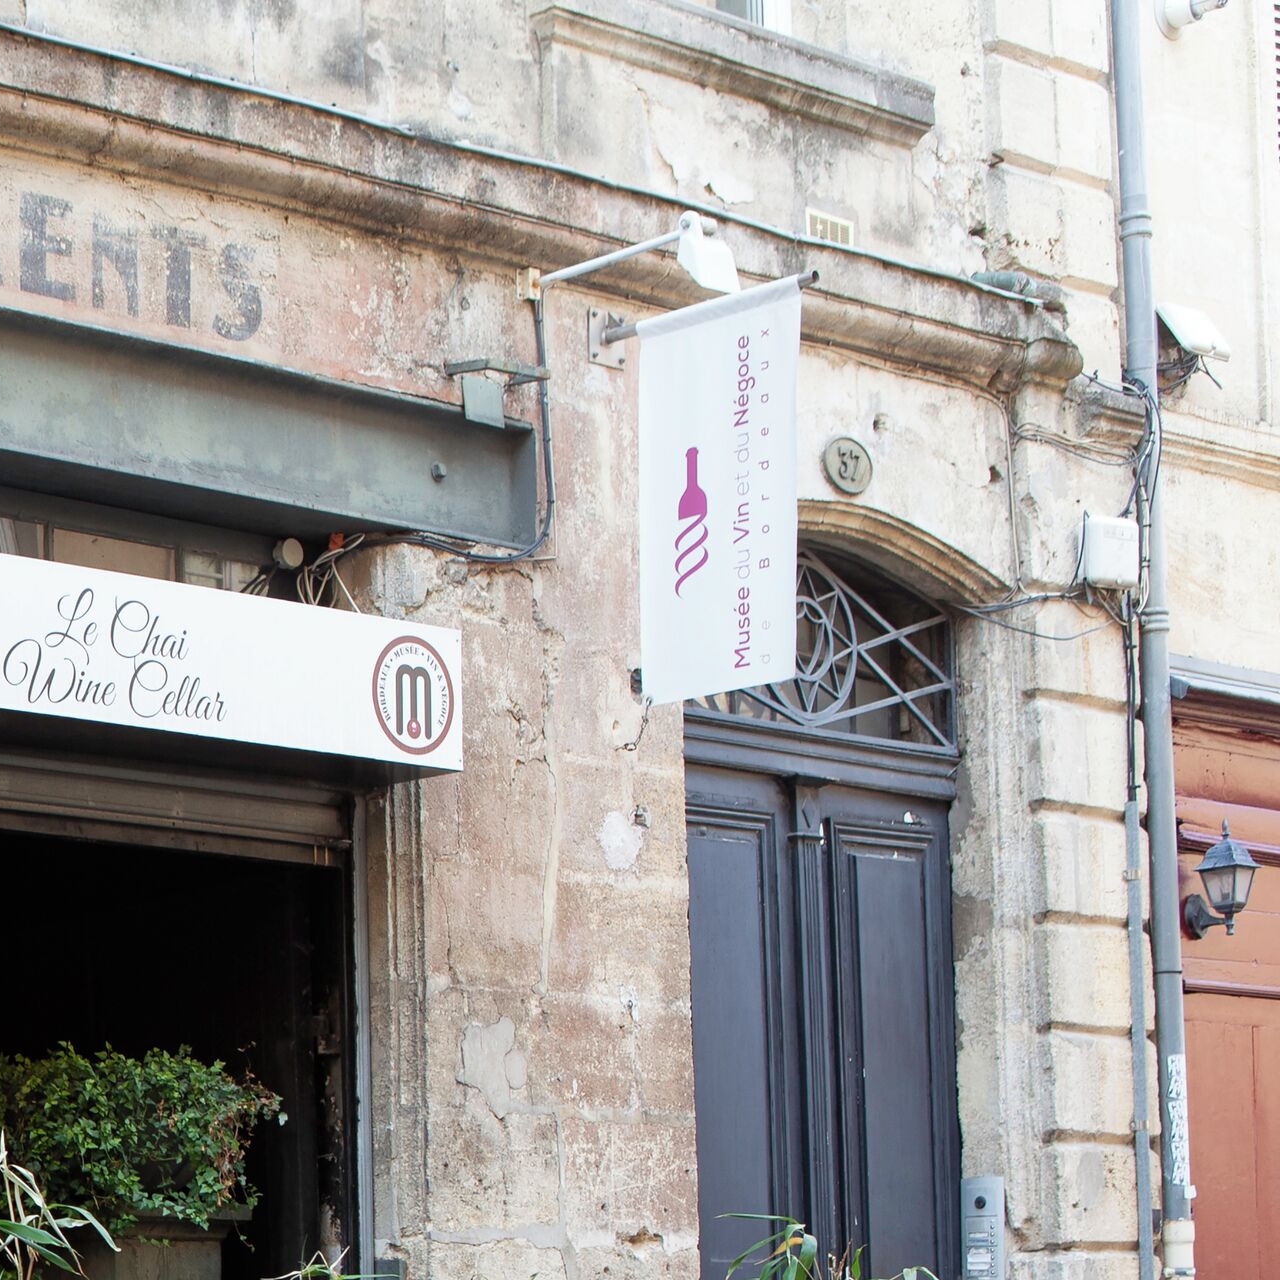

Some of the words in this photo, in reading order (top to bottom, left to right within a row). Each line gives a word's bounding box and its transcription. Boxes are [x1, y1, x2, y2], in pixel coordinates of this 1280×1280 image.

[733, 335, 756, 428] Négoce
[734, 432, 750, 464] du
[734, 471, 750, 496] et
[733, 502, 750, 545] Vin
[733, 549, 751, 580] du
[44, 588, 98, 665] Le
[110, 595, 189, 660] Chai
[734, 586, 751, 669] Musée
[3, 638, 116, 706] Wine
[129, 656, 227, 722] Cellar
